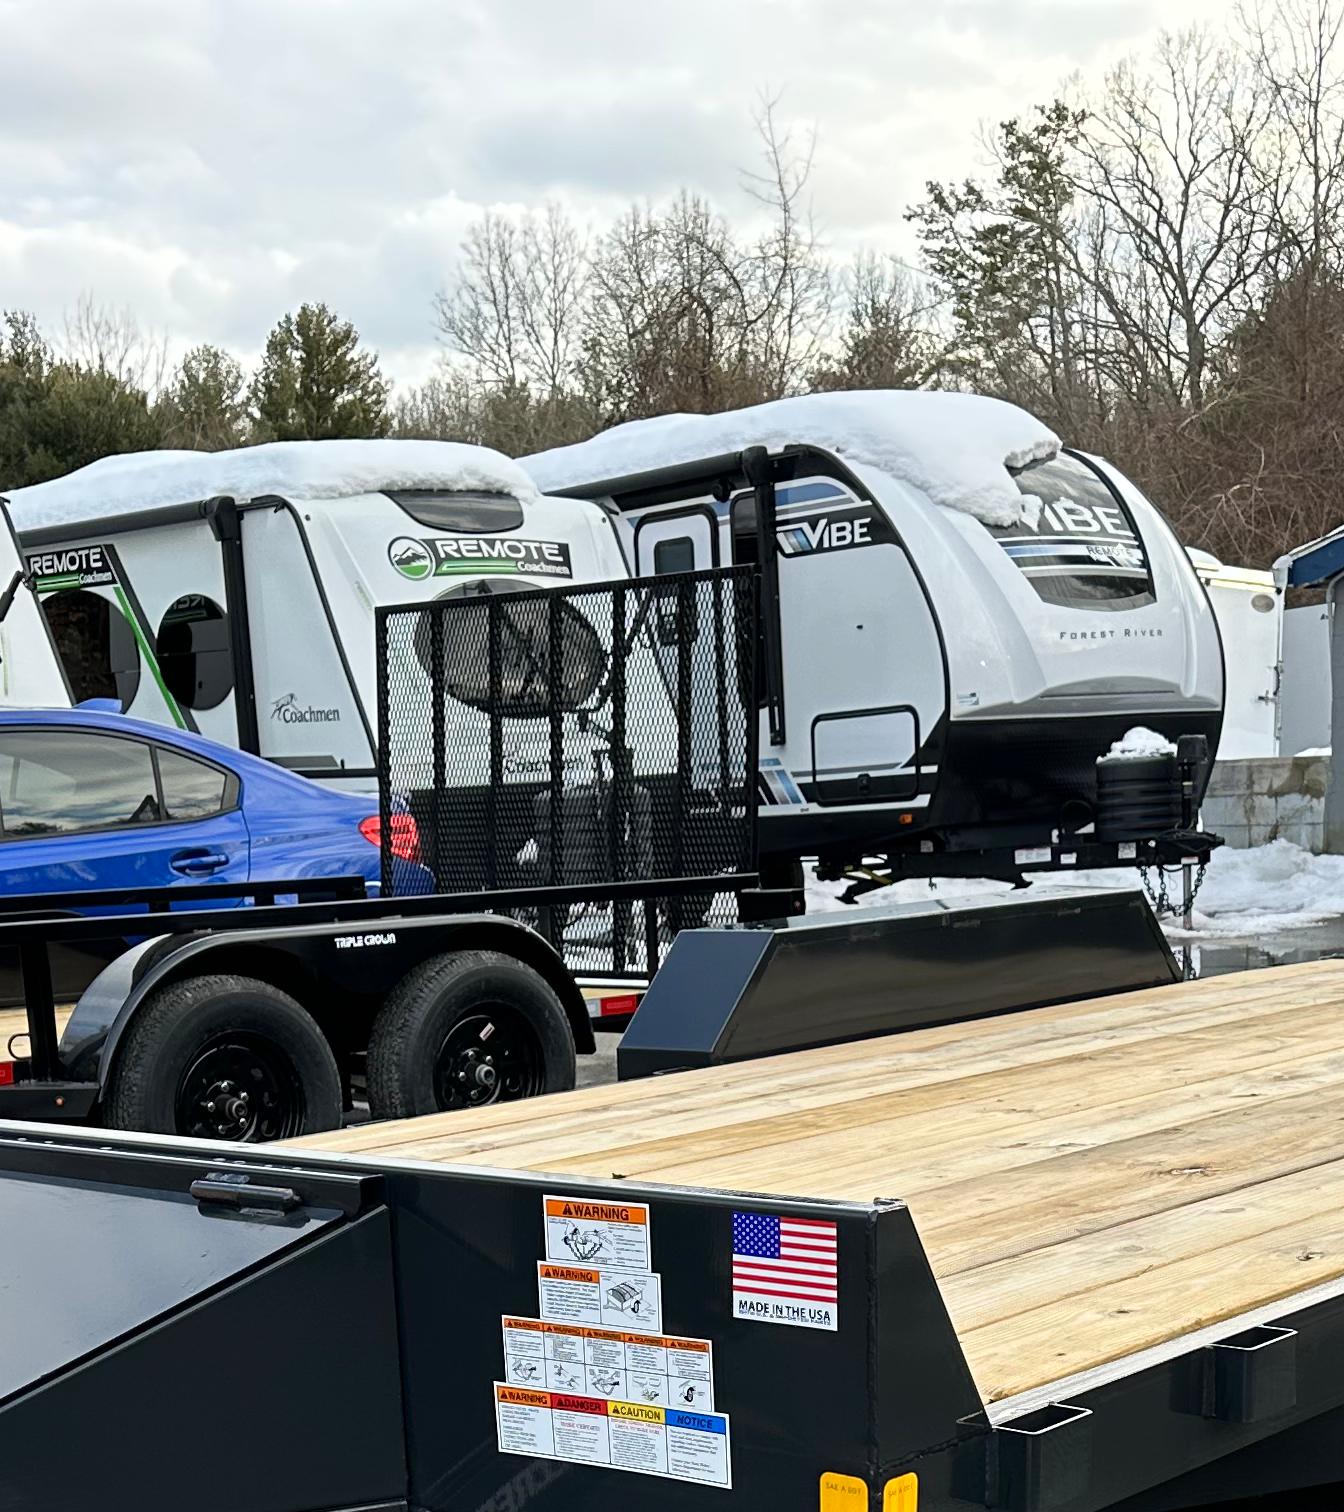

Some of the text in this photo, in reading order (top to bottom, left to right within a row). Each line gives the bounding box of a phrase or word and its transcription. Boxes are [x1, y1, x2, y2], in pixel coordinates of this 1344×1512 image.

[777, 517, 872, 552] VIBE
[435, 540, 564, 561] REMOTE
[30, 547, 103, 575] REMOTE
[517, 560, 571, 575] Coachmen
[1059, 628, 1164, 640] FOREST RIVER
[282, 705, 341, 723] Coachmen
[334, 933, 397, 949] TRIPLE CROWN
[573, 1203, 629, 1221] WARNING
[551, 1269, 593, 1282] WARNING
[738, 1299, 769, 1314] MADE
[772, 1303, 783, 1315] IN
[785, 1305, 806, 1318] THE
[808, 1308, 831, 1321] USA
[507, 1391, 548, 1405] WARNING
[563, 1397, 602, 1411] DANGER
[619, 1405, 661, 1421] CAUTION
[676, 1415, 713, 1429] NOTICE
